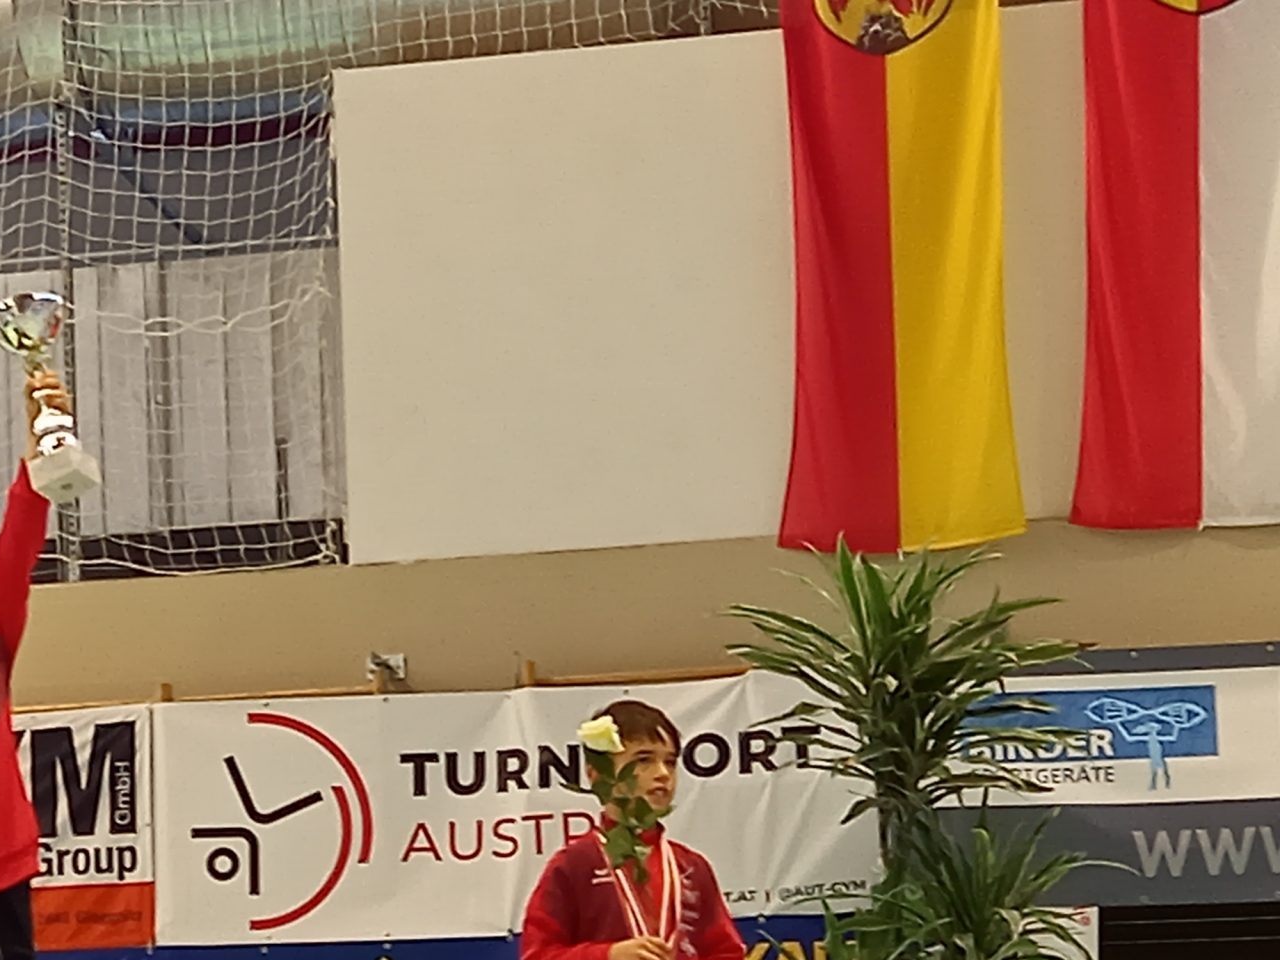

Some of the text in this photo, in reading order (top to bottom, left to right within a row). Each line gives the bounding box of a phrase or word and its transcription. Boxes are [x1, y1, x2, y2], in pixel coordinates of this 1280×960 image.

[400, 726, 822, 797] TURNORT
[114, 761, 131, 825] GmbH
[38, 842, 138, 881] Group
[401, 811, 598, 862] AUSTR
